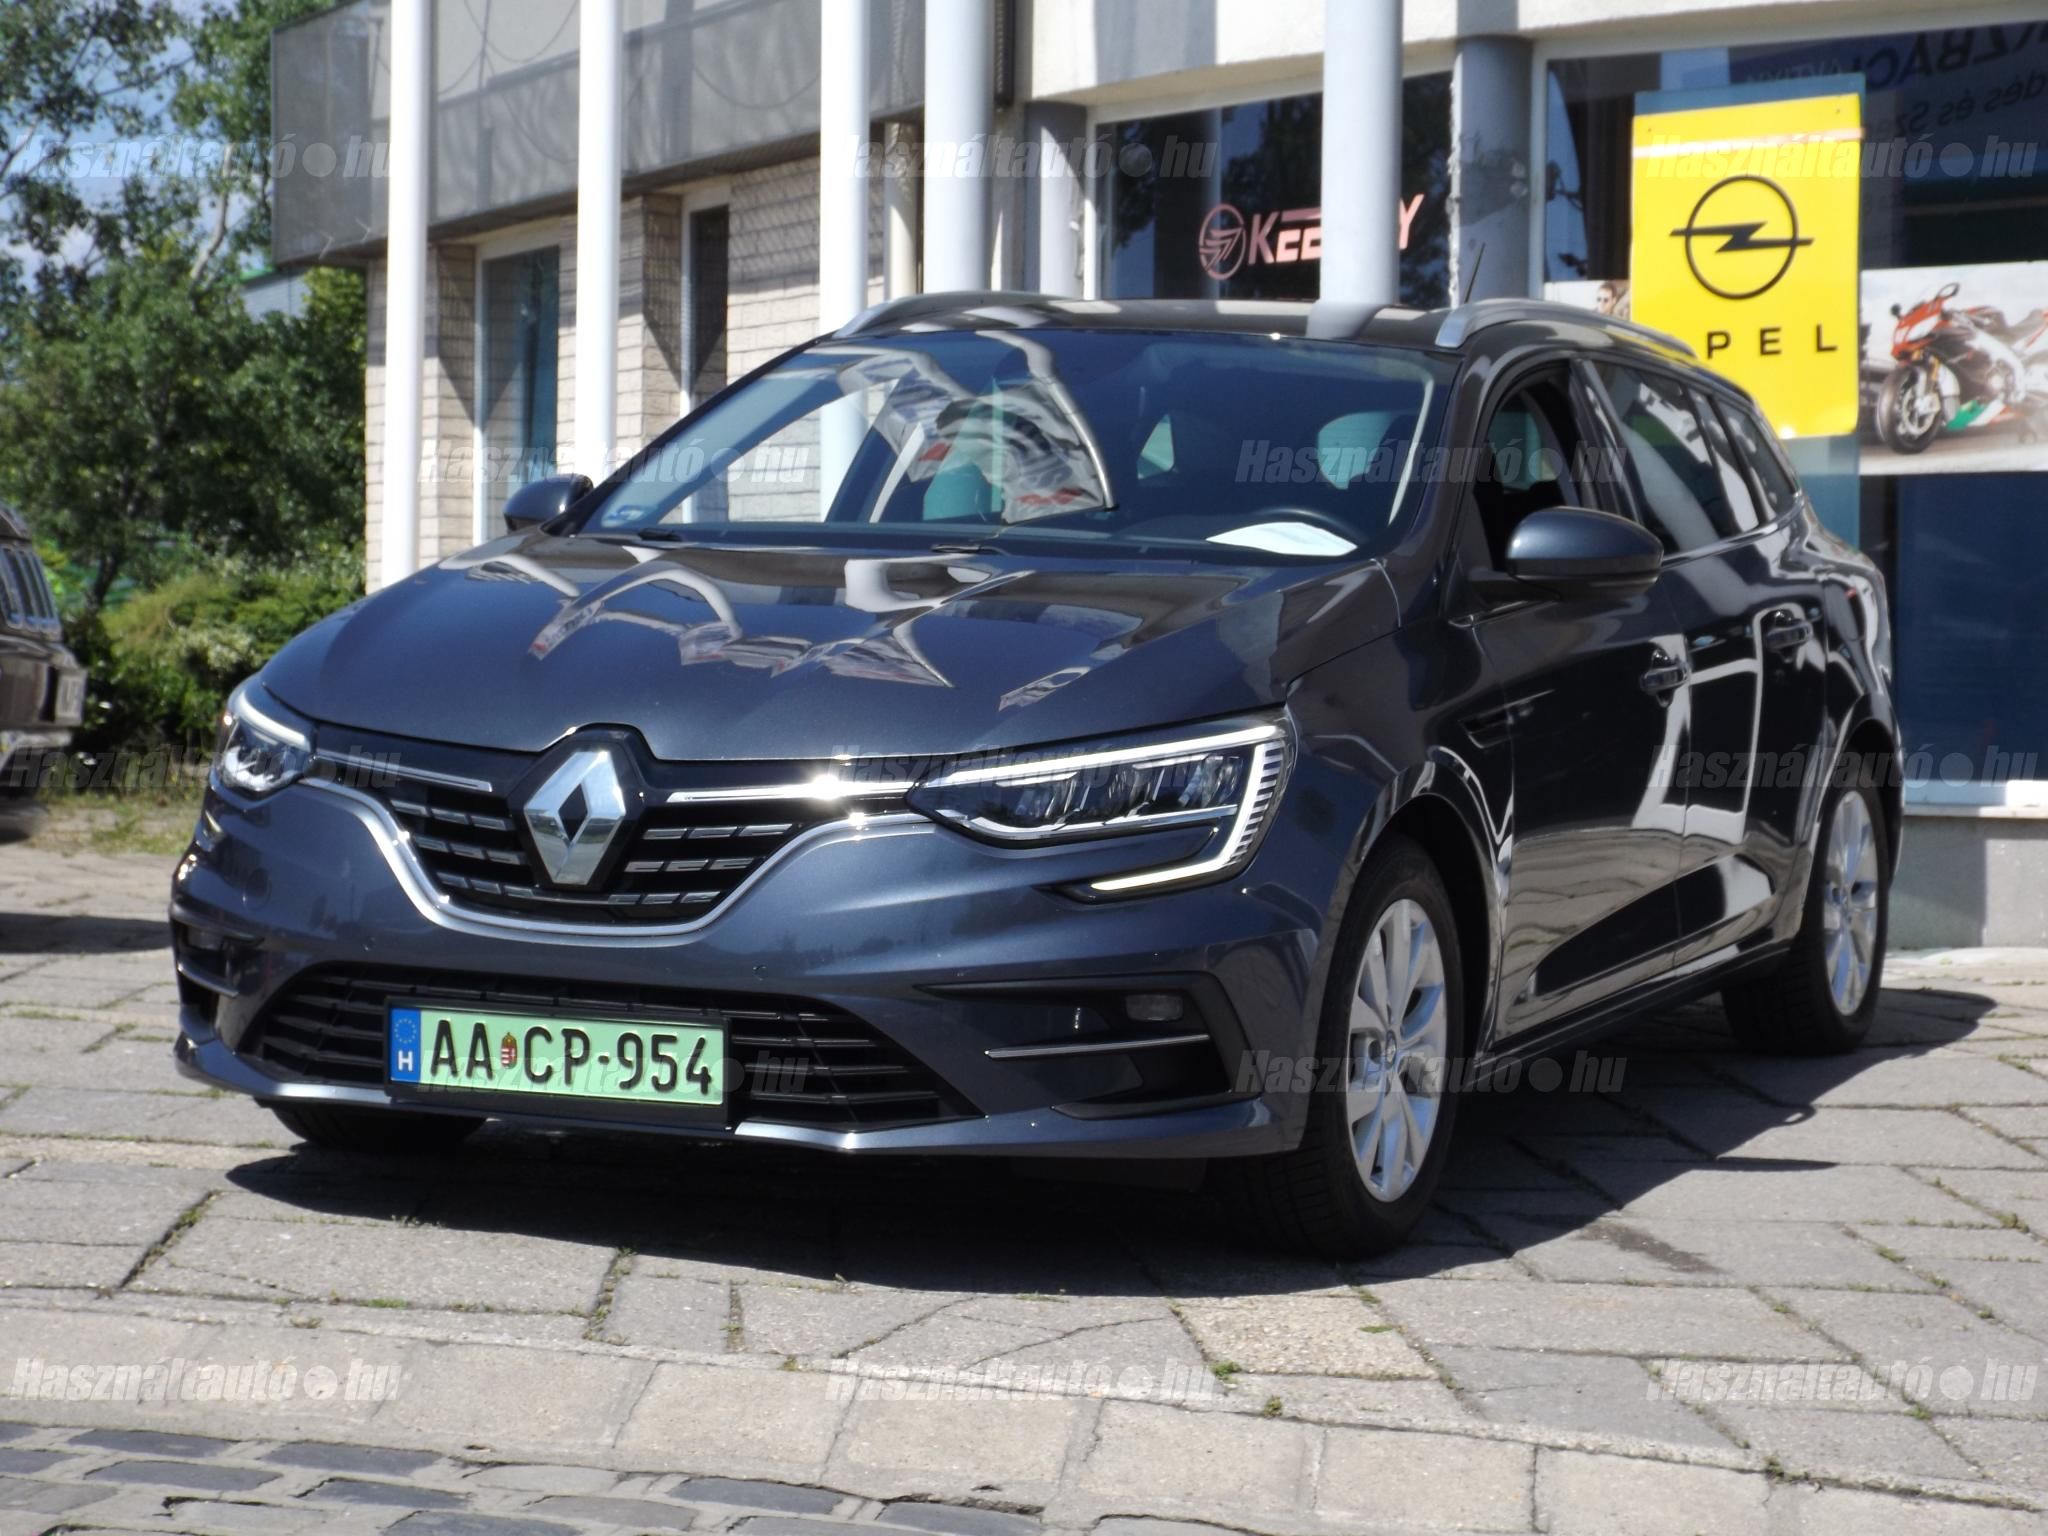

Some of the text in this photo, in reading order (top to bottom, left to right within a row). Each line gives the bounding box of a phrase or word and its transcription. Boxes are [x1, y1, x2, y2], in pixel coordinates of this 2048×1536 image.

[1248, 193, 1424, 265] KEEY
[1706, 324, 1838, 360] PEL
[397, 1050, 413, 1073] H
